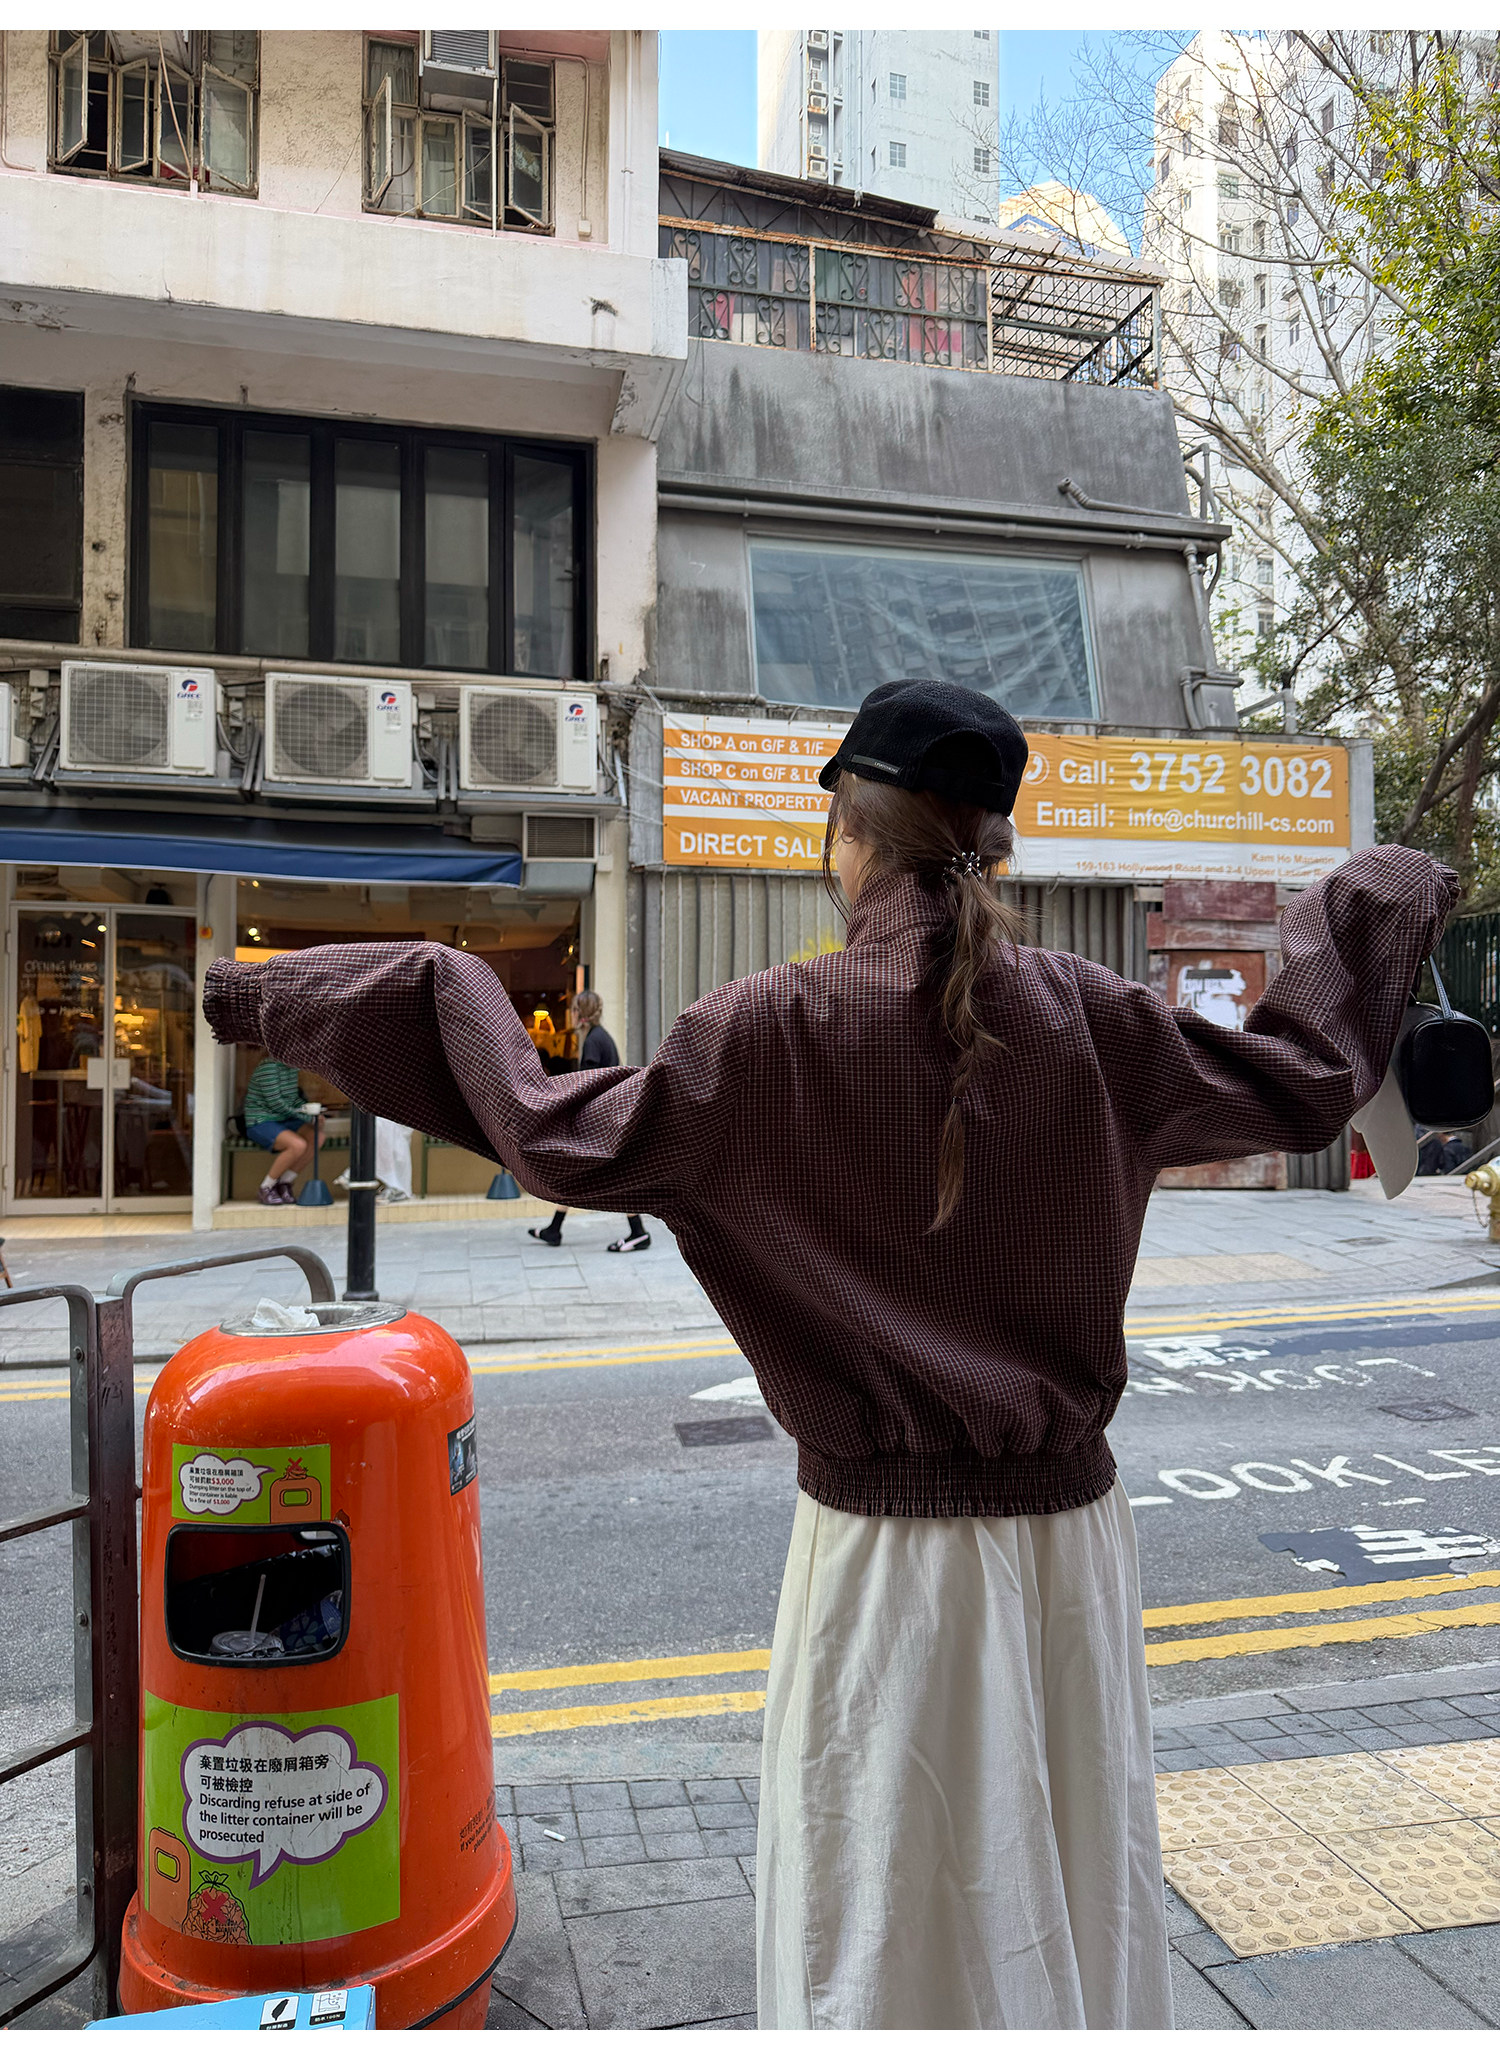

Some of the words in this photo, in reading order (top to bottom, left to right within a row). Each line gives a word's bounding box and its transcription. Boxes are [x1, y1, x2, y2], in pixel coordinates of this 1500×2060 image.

[681, 733, 722, 748] SHOP
[725, 737, 736, 749] A
[739, 741, 757, 751] on
[761, 738, 785, 753] G/F
[789, 740, 799, 754] &
[803, 741, 824, 755] 1/F
[681, 761, 722, 778] SHOP
[726, 764, 737, 778] C
[740, 768, 758, 779] on
[762, 765, 786, 780] G/F
[790, 767, 801, 781] &
[1059, 758, 1116, 785] Call:
[1129, 752, 1226, 793] 3752
[1239, 756, 1333, 799] 3082
[680, 789, 741, 806] VACANT
[745, 792, 823, 810] PROPERTY
[1037, 801, 1115, 828] Email:
[1128, 808, 1335, 834] info@churchill-cs.com
[680, 831, 767, 857] DIRECT
[200, 1754, 329, 1773] 棄置垃圾在廢屑箱旁
[200, 1775, 253, 1793] 可被檢控
[200, 1793, 261, 1812] Discarding
[264, 1796, 305, 1809] refuse
[309, 1794, 323, 1806] at
[326, 1789, 353, 1804] side
[356, 1782, 371, 1797] of
[200, 1811, 217, 1823] the
[220, 1812, 250, 1826] litter
[252, 1811, 315, 1827] container
[318, 1806, 343, 1822] will
[346, 1803, 363, 1817] be
[200, 1828, 264, 1843] prosecuted
